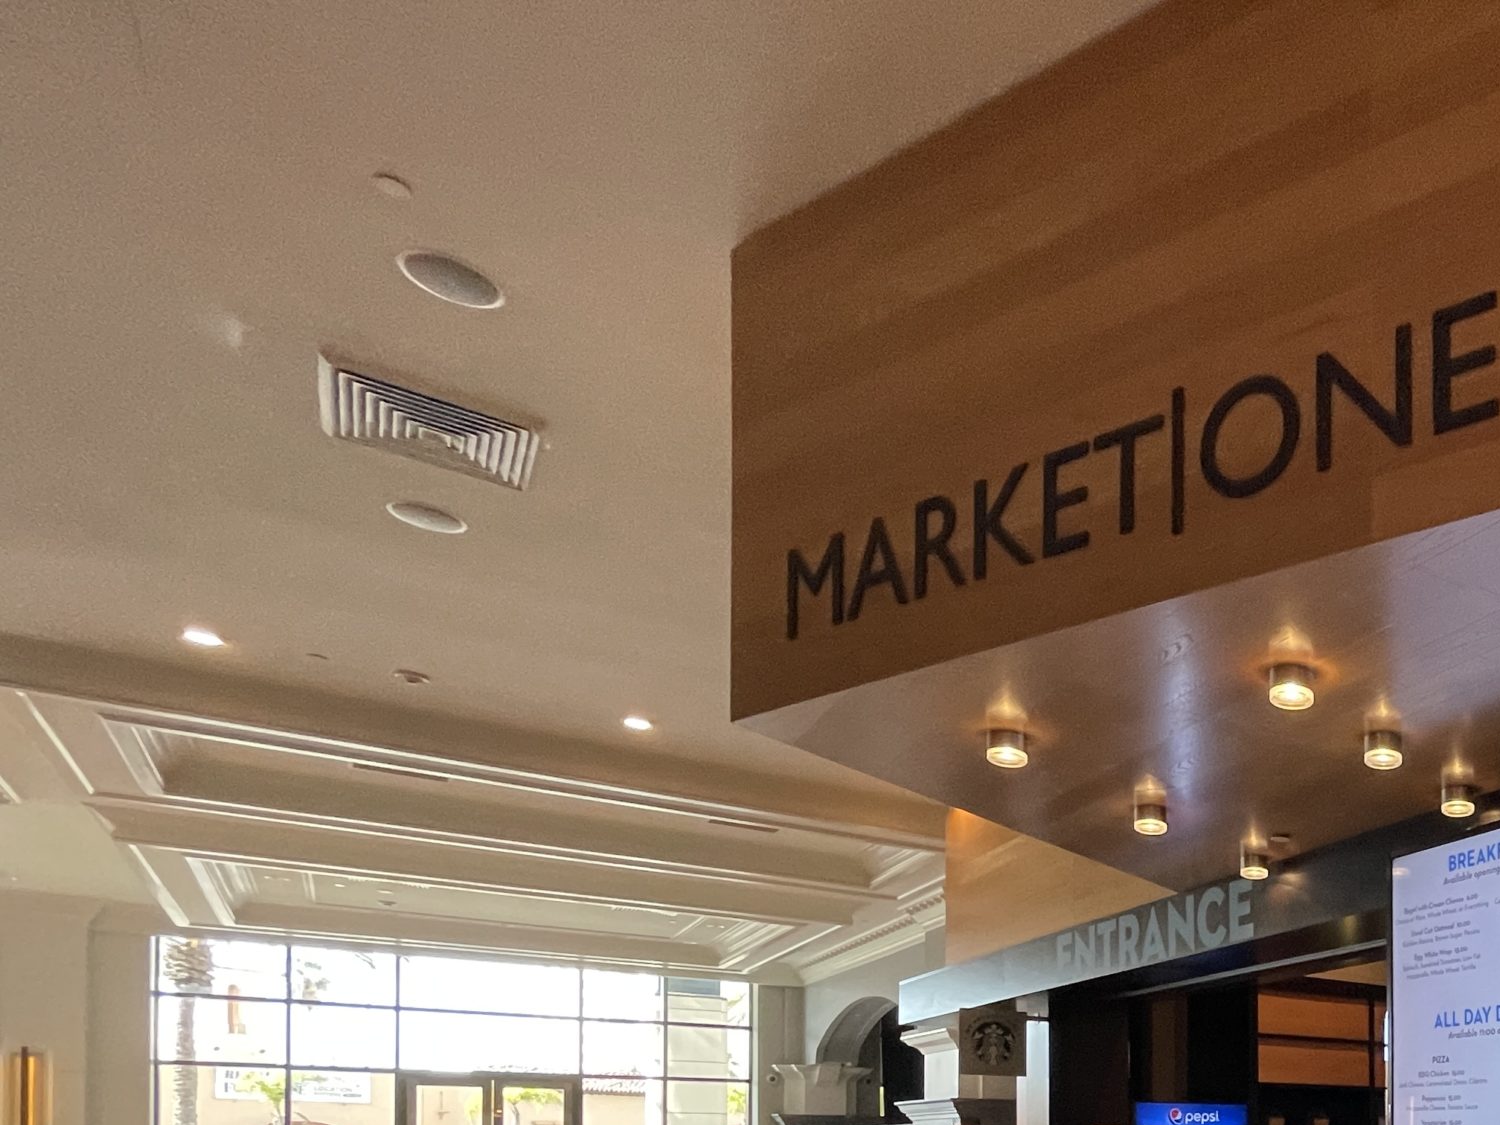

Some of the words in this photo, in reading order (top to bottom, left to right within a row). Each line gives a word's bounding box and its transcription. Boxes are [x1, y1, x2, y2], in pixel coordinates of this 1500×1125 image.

[1056, 879, 1255, 973] ENTRANCE
[1433, 1010, 1461, 1029] ALL
[1463, 1004, 1492, 1026] DAY
[1430, 1054, 1450, 1065] PIZZA
[1185, 1110, 1221, 1125] pepsi
